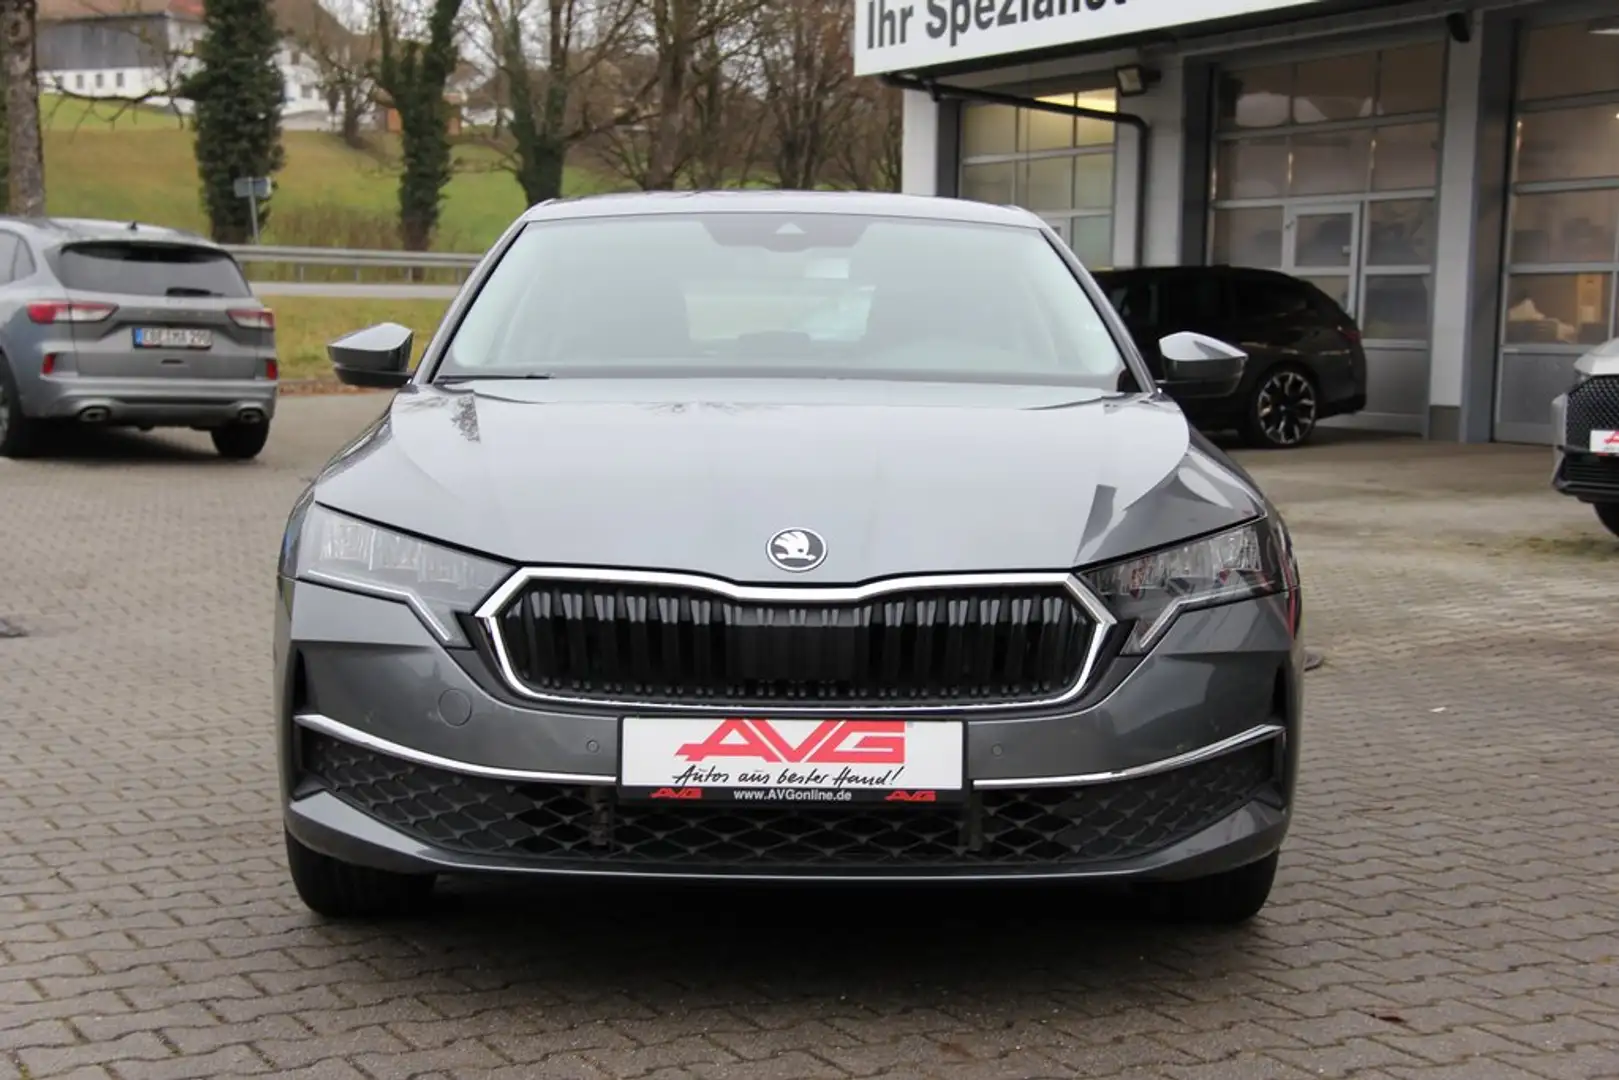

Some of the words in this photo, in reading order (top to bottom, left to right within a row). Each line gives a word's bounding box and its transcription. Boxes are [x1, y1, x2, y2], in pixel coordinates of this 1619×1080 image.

[867, 0, 914, 49] Ihr
[673, 718, 905, 763] AVG
[672, 764, 730, 786] Autos
[738, 769, 770, 784] aus
[777, 767, 829, 784] bester
[832, 765, 905, 787] Hand!
[650, 787, 702, 799] AVG
[733, 788, 852, 802] www.AVGonline.de
[885, 789, 937, 802] AVG
